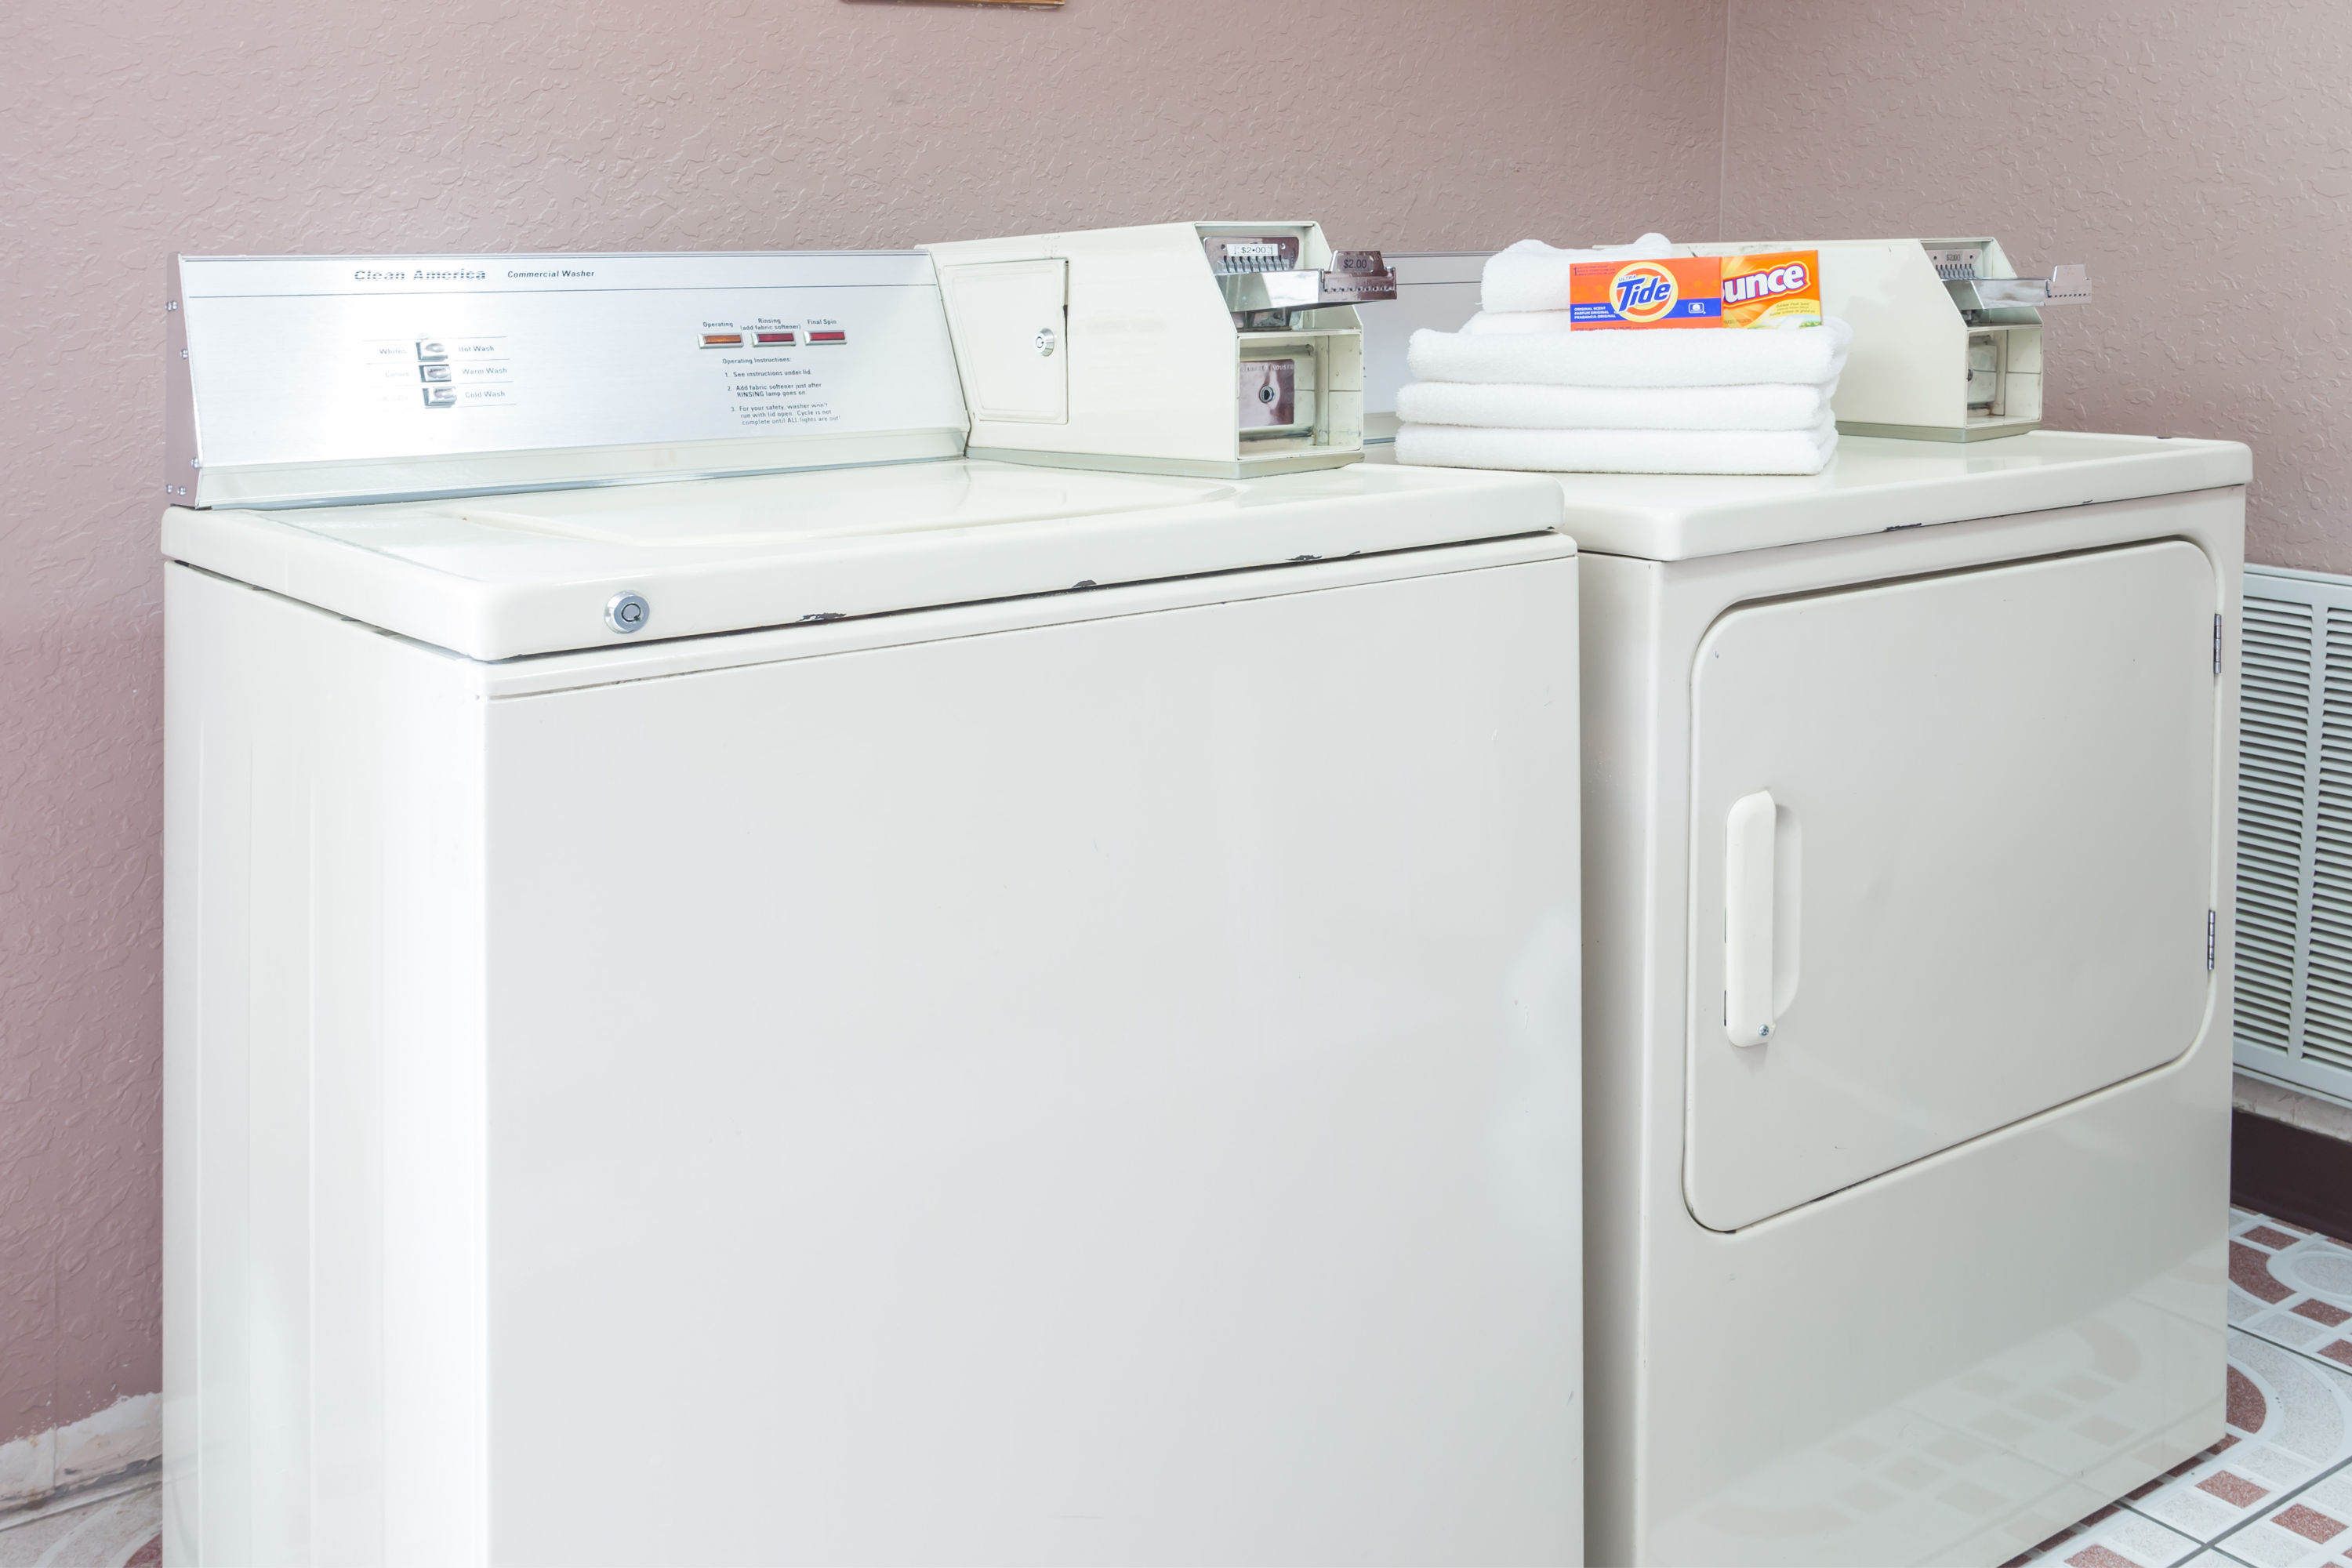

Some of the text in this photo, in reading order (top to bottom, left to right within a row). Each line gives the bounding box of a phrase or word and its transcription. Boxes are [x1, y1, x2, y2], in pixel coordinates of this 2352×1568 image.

[354, 268, 595, 281] Clean America Commercial Washer
[1343, 260, 1367, 269] $2.00
[1617, 276, 1671, 314] Tide
[1723, 265, 1805, 303] unce
